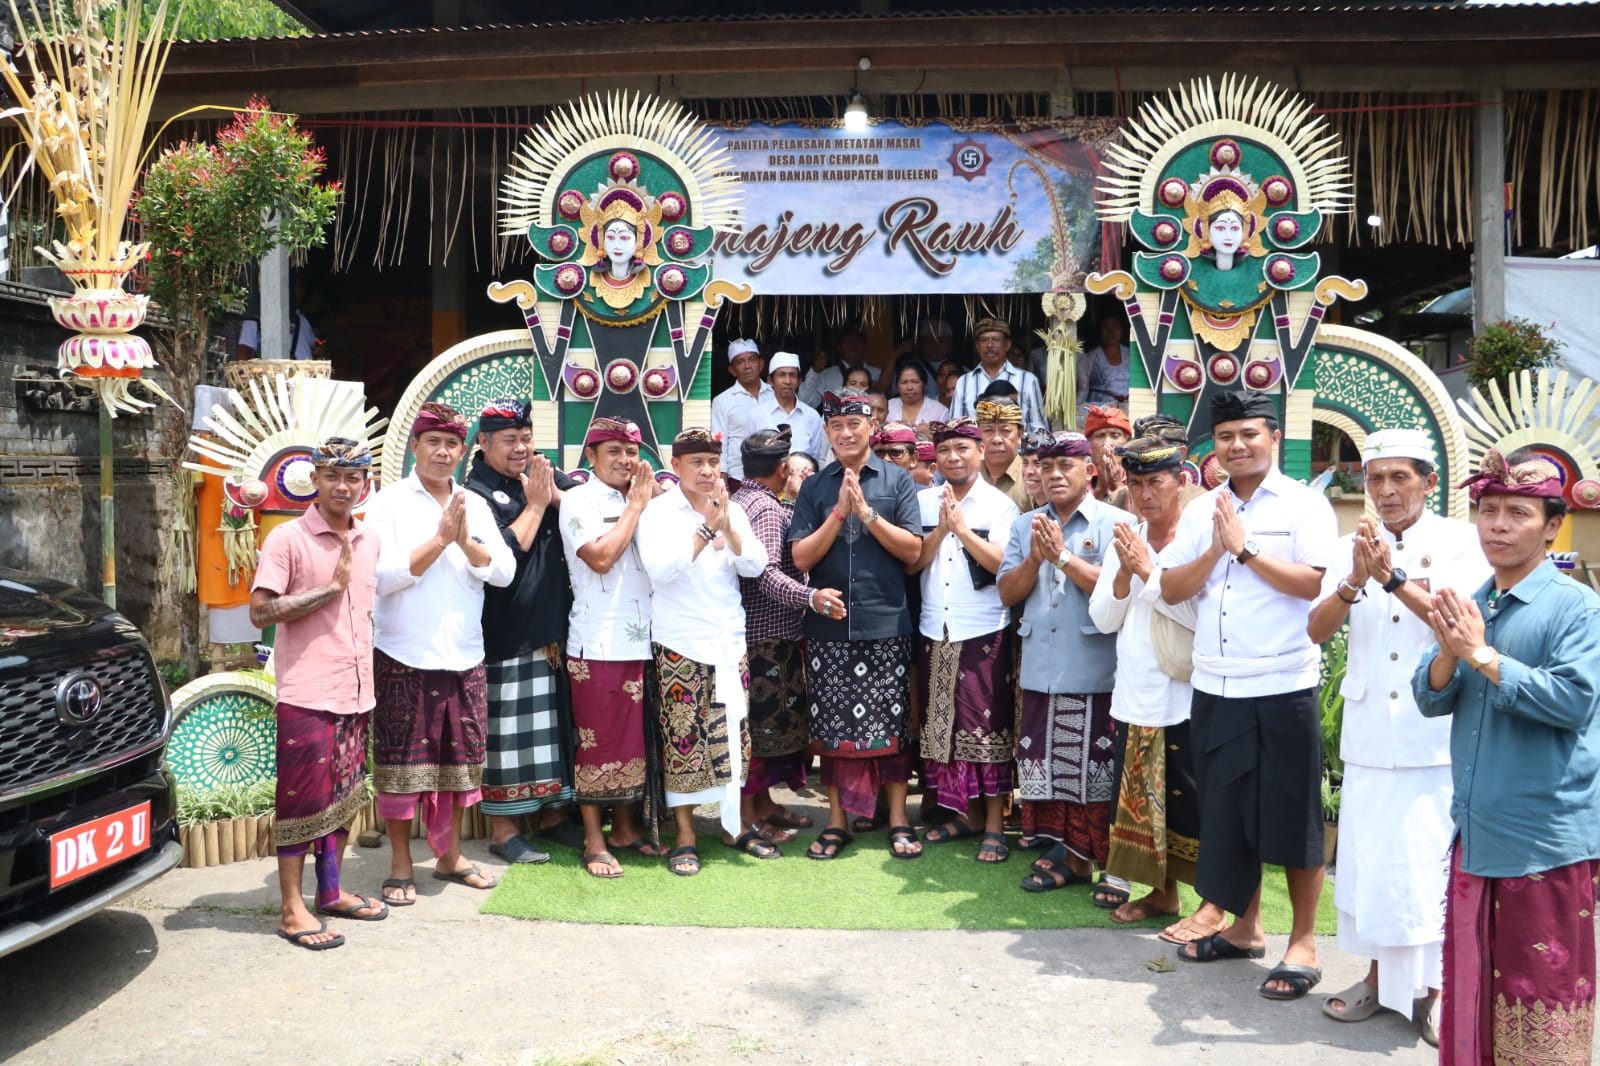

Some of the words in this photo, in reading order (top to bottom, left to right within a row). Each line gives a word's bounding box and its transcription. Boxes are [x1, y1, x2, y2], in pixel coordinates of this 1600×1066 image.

[727, 139, 769, 151] PANITIA
[772, 138, 831, 150] PELAKSANA
[834, 138, 882, 149] METATAH
[886, 137, 921, 149] MASAL
[769, 154, 796, 166] DESA
[798, 154, 826, 165] ADAT
[828, 153, 879, 165] CEMPAGA
[779, 170, 819, 182] BANJAR
[822, 169, 884, 181] KABUPATEN
[887, 168, 939, 181] BULELENG
[883, 196, 1024, 274] Rauh
[55, 828, 98, 879] DK
[106, 820, 124, 858] 2
[131, 810, 147, 847] U
